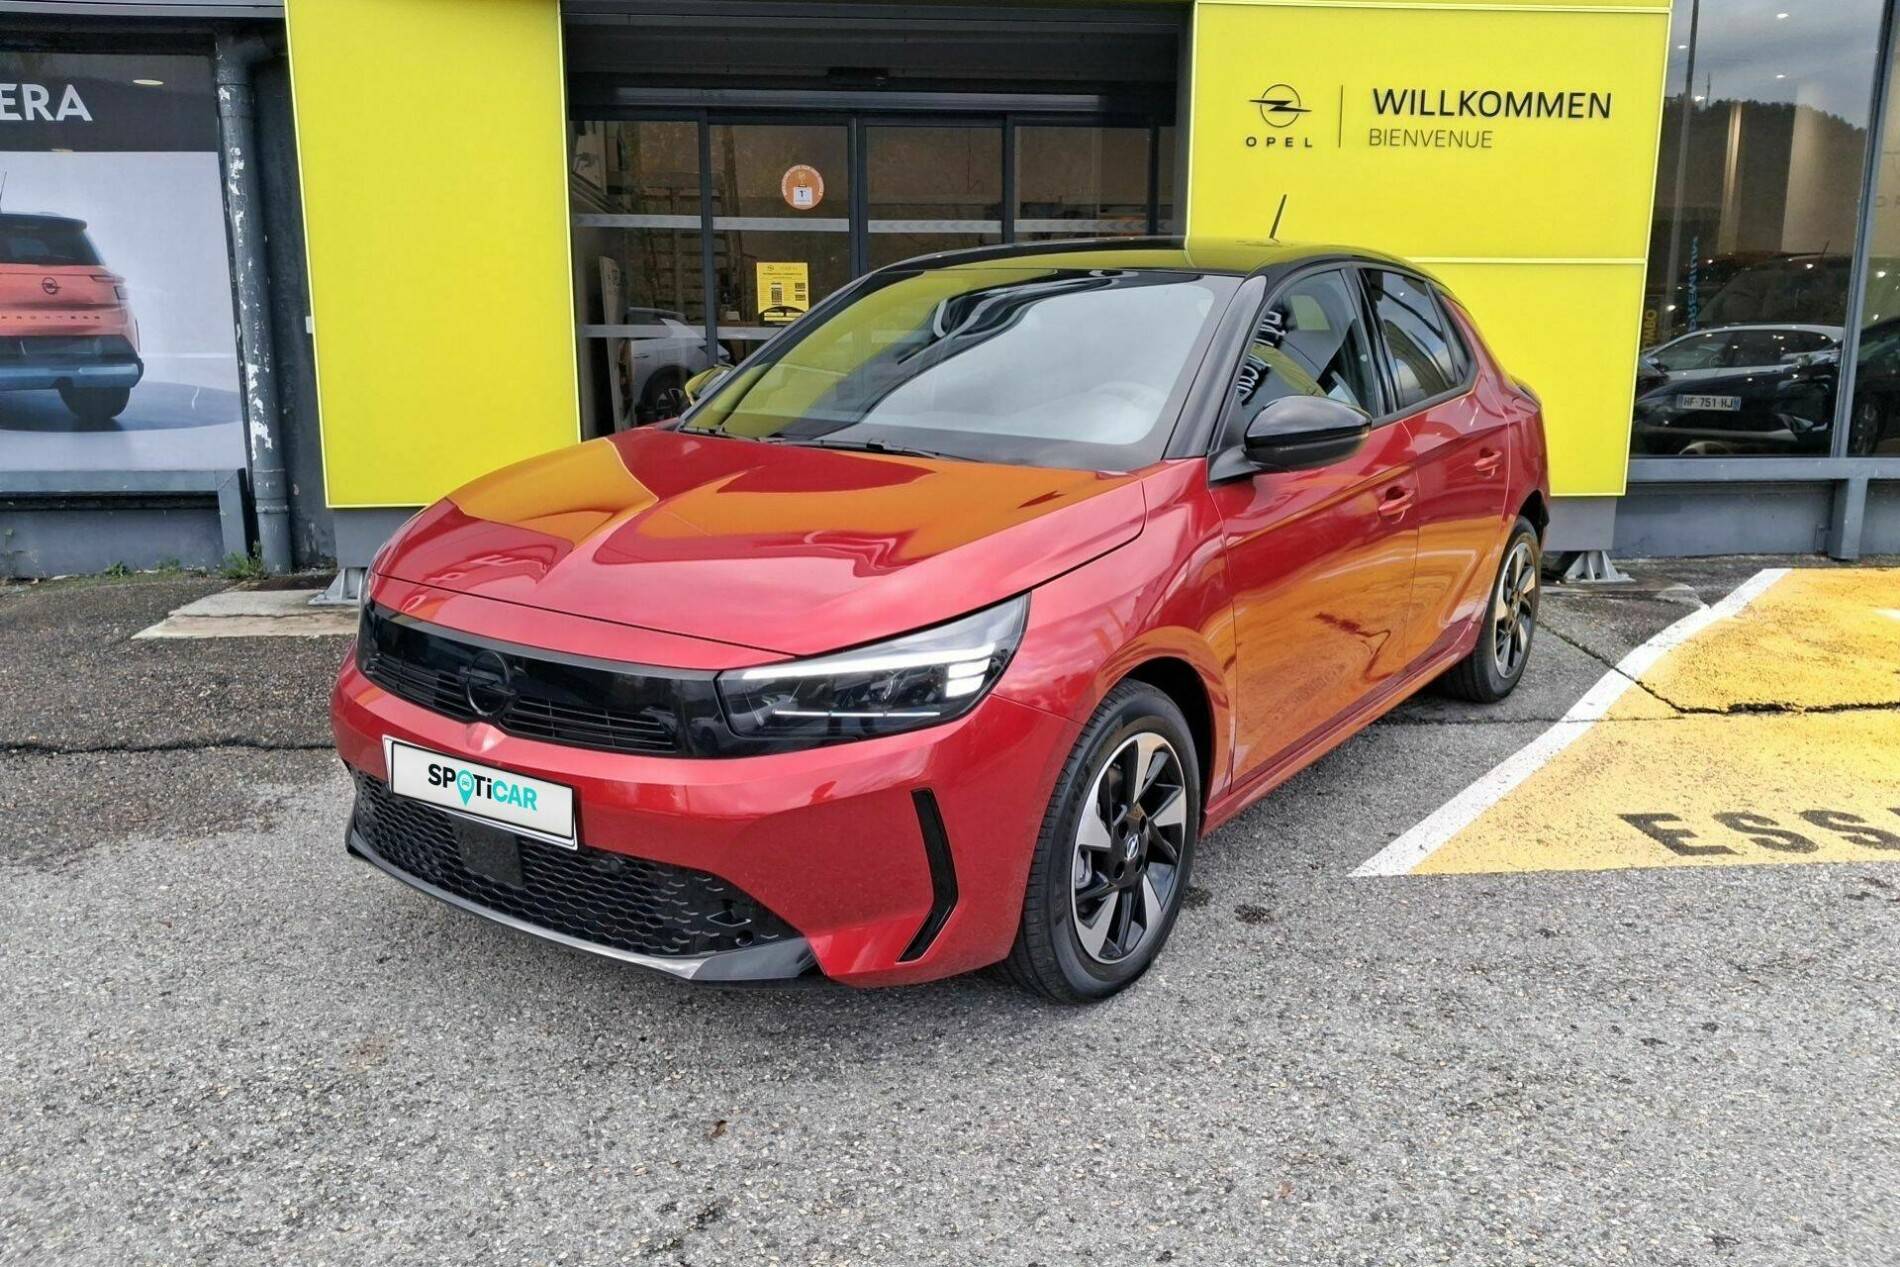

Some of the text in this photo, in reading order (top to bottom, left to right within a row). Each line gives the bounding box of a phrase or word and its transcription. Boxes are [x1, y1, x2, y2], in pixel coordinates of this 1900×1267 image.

[0, 84, 94, 122] ERA
[1373, 88, 1612, 119] WILLKOMMEN
[1245, 136, 1313, 148] OPEL
[1369, 128, 1494, 149] BIENVENUE
[1617, 808, 1900, 857] ESS
